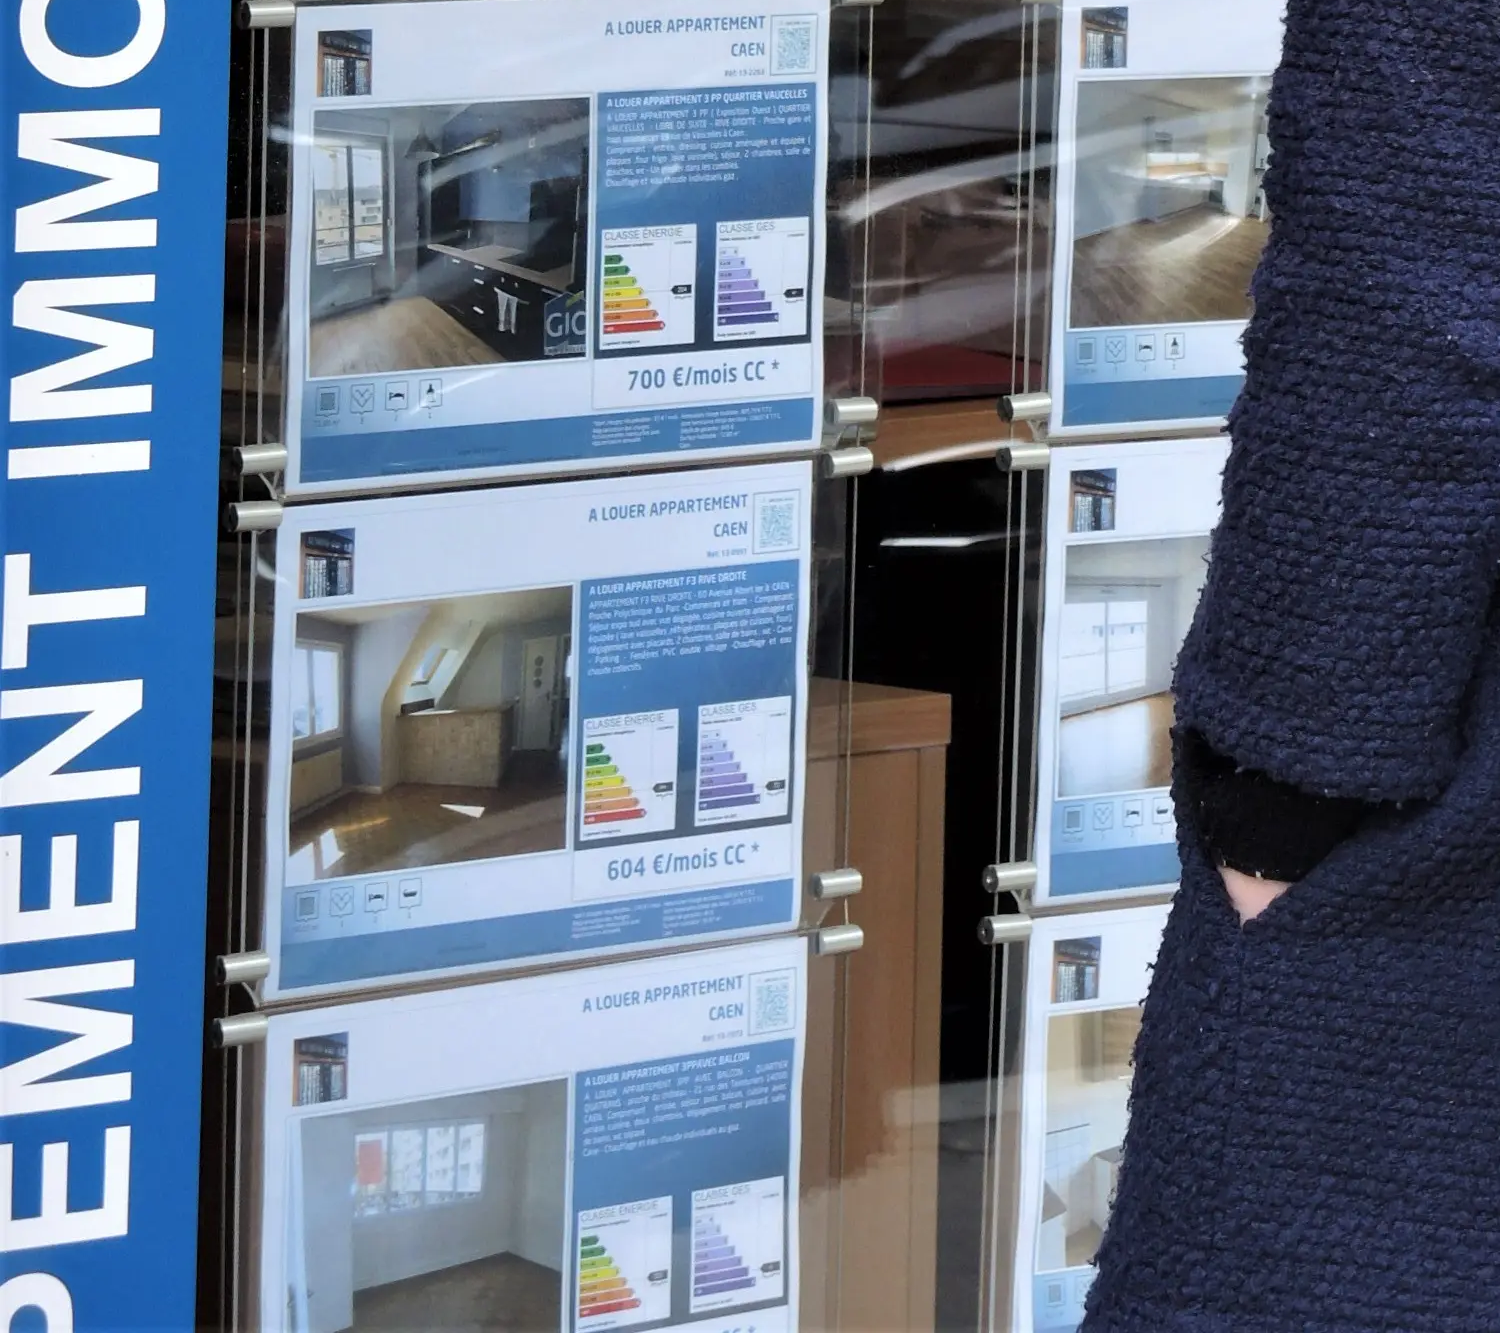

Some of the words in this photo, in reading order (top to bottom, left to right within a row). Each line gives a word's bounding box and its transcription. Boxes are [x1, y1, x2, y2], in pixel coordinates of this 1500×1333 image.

[604, 22, 614, 35] A
[618, 20, 662, 35] LOUER
[666, 15, 766, 33] APPARTEMENT
[731, 42, 766, 57] CAEN
[615, 96, 642, 107] LOUER
[643, 94, 702, 106] APPARTEMENT
[764, 89, 808, 100] VAUCELLES
[628, 368, 666, 391] 700
[673, 361, 738, 388] €/mois
[744, 360, 766, 381] CC
[588, 507, 598, 523] A
[602, 503, 646, 521] LOUER
[650, 494, 748, 517] APPARTEMENT
[714, 521, 748, 538] CAEN
[607, 857, 646, 881] 604
[653, 847, 718, 875] €/mois
[724, 843, 746, 865] CC
[582, 997, 592, 1013] A
[596, 990, 640, 1011] LOUER
[644, 975, 744, 1004] APPARTEMENT
[709, 1003, 744, 1021] CAEN
